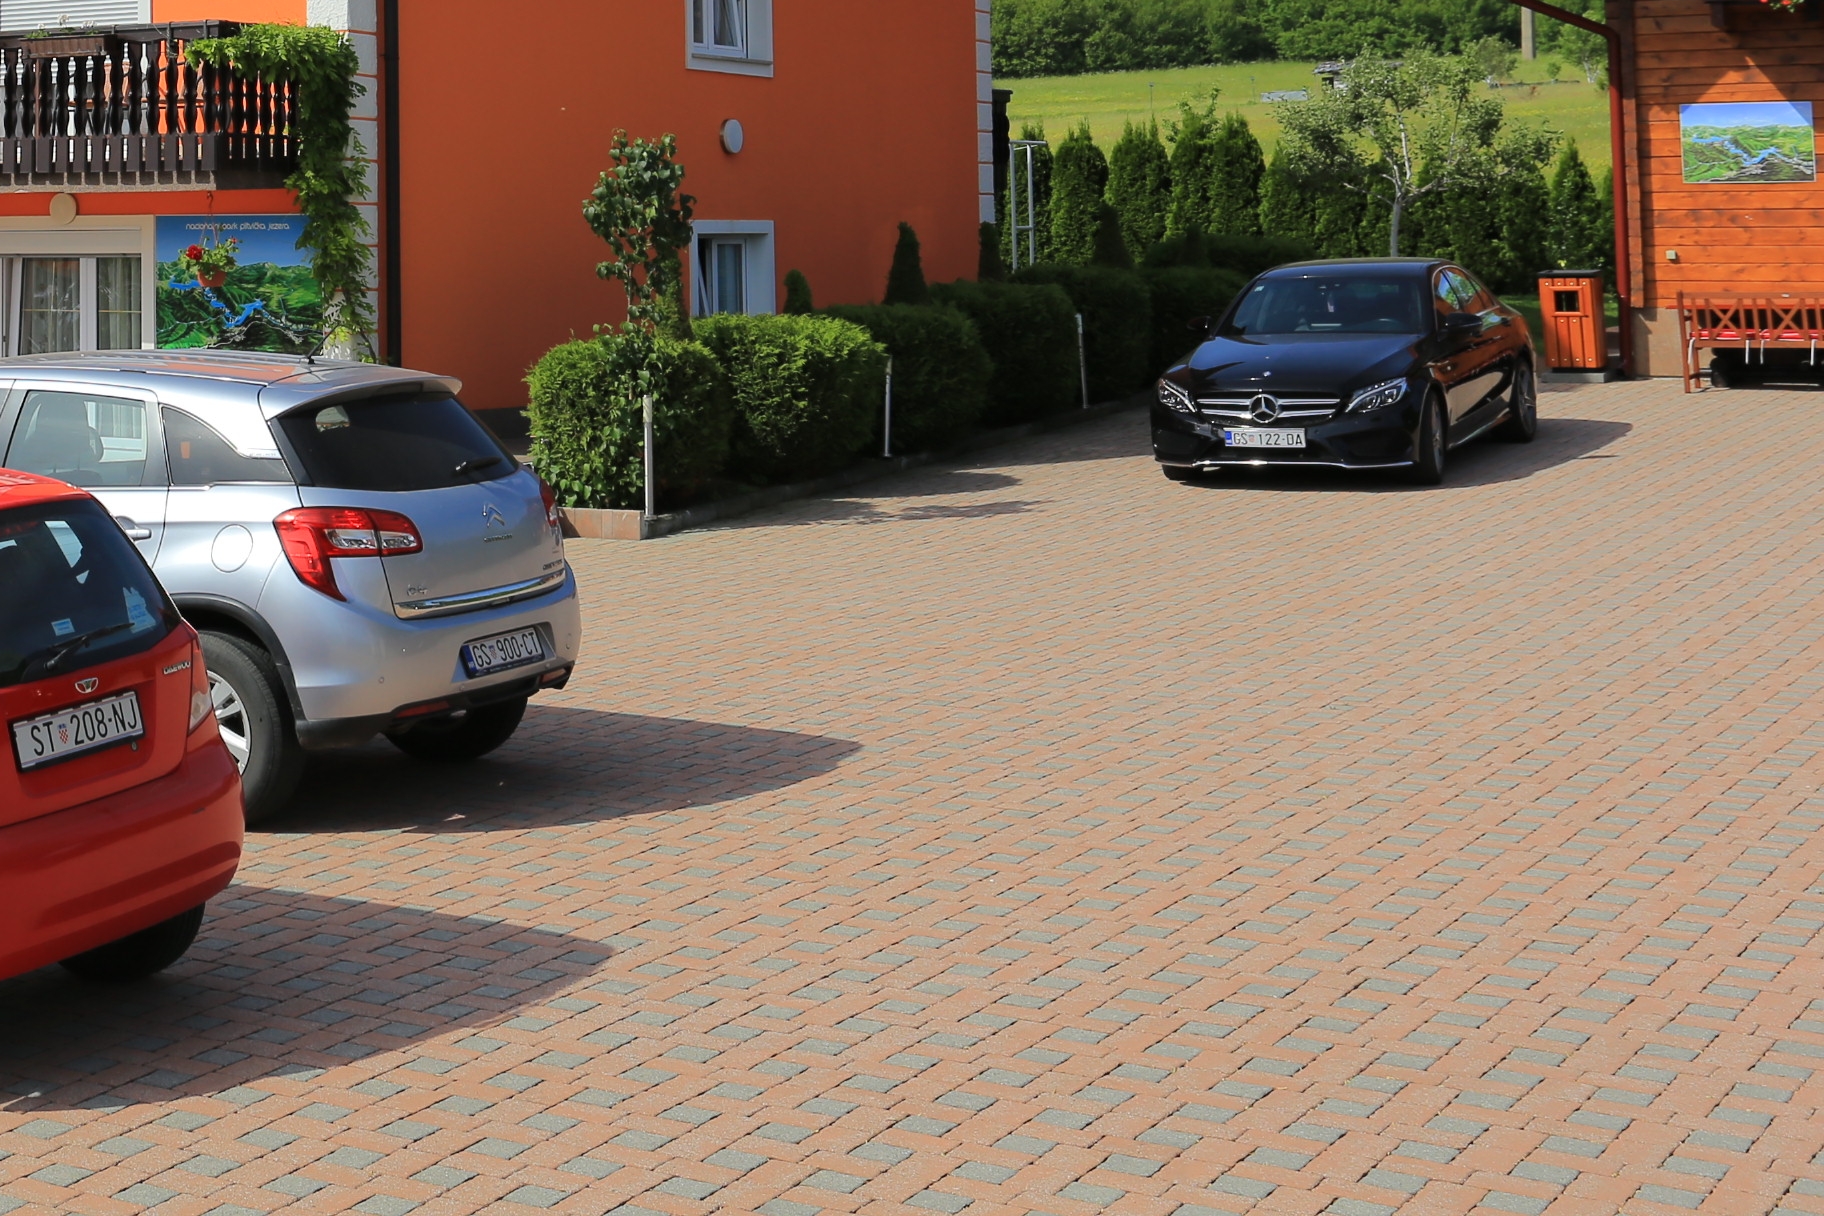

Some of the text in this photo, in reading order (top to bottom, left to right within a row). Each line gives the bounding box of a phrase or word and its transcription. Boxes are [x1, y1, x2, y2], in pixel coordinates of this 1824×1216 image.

[267, 222, 290, 232] jezera
[1233, 432, 1303, 446] GS 122-DA
[472, 643, 492, 668] GS
[496, 632, 536, 662] 900-CT
[163, 660, 191, 675] DAEWOO
[30, 698, 138, 757] ST 208-NJ
